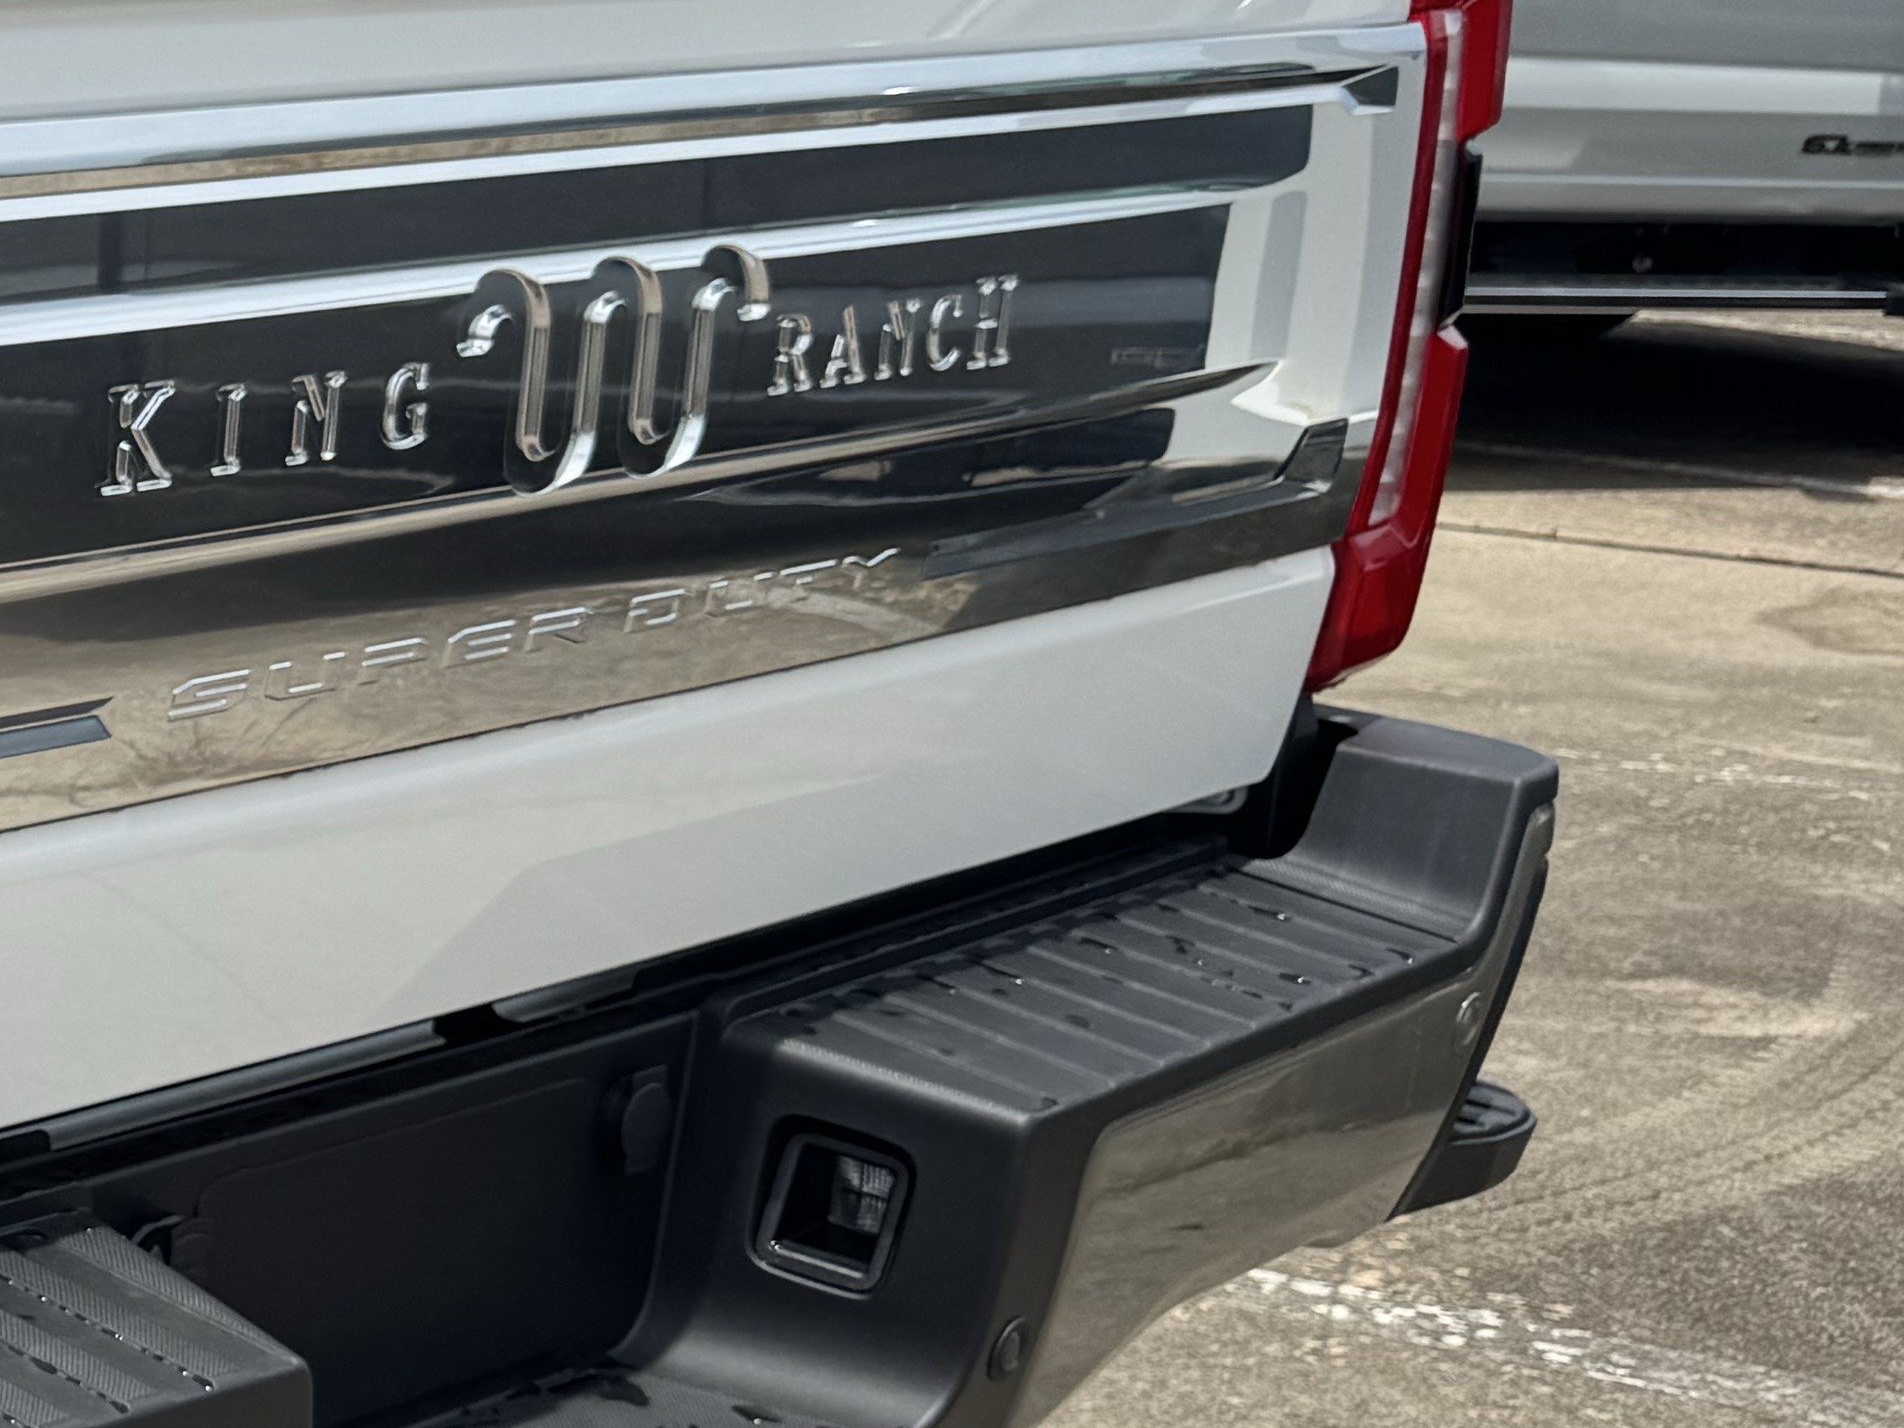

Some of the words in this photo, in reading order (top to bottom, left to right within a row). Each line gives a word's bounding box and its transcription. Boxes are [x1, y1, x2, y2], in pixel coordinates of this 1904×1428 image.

[97, 362, 432, 497] KING
[766, 274, 1020, 397] RANCH
[167, 606, 594, 722] SUPER
[623, 547, 901, 634] DUTY
